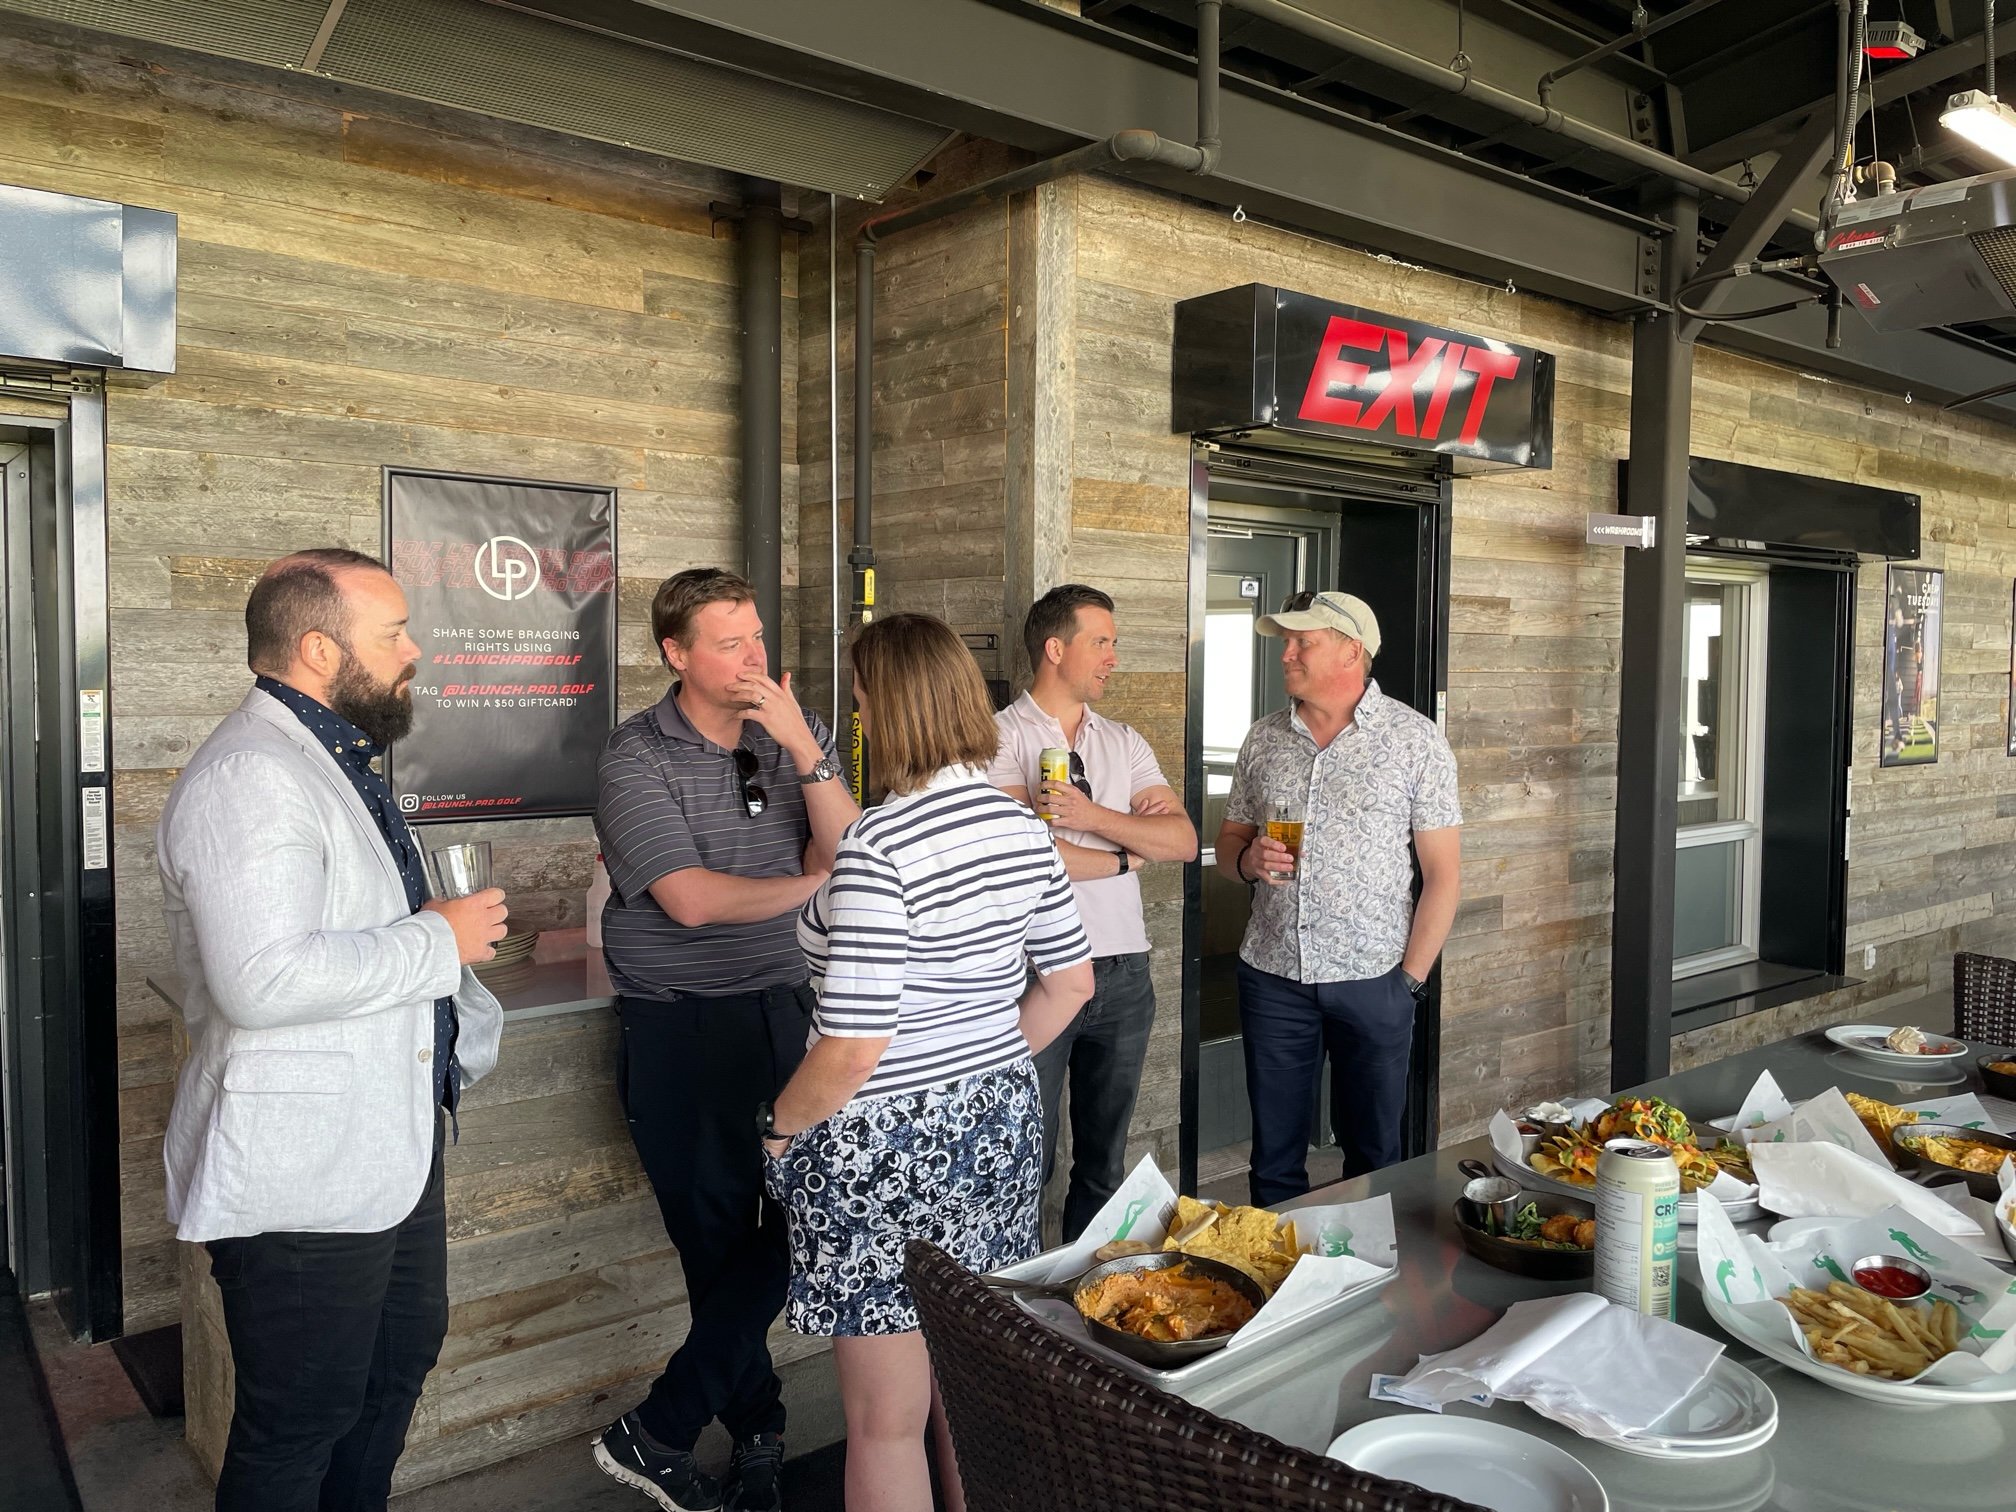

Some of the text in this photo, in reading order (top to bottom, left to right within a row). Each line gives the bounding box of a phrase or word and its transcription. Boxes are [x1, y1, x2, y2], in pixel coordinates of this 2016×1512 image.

[1297, 315, 1521, 446] EXIT
[433, 628, 580, 640] SHARE SOME BRAGGING
[465, 642, 552, 653] RIGHTS USING
[432, 654, 582, 666] #LAUNCHPADGOLF
[415, 683, 595, 697] TAG @LAUNCH.PAD.GOLF
[436, 698, 577, 708] TO WIN A $50 GIFTCARD!
[851, 717, 860, 749] GAS
[421, 794, 453, 802] FOLLOW
[421, 797, 522, 811] @LAUNCH.PAD.GOLF
[1655, 1201, 1678, 1217] CRF
